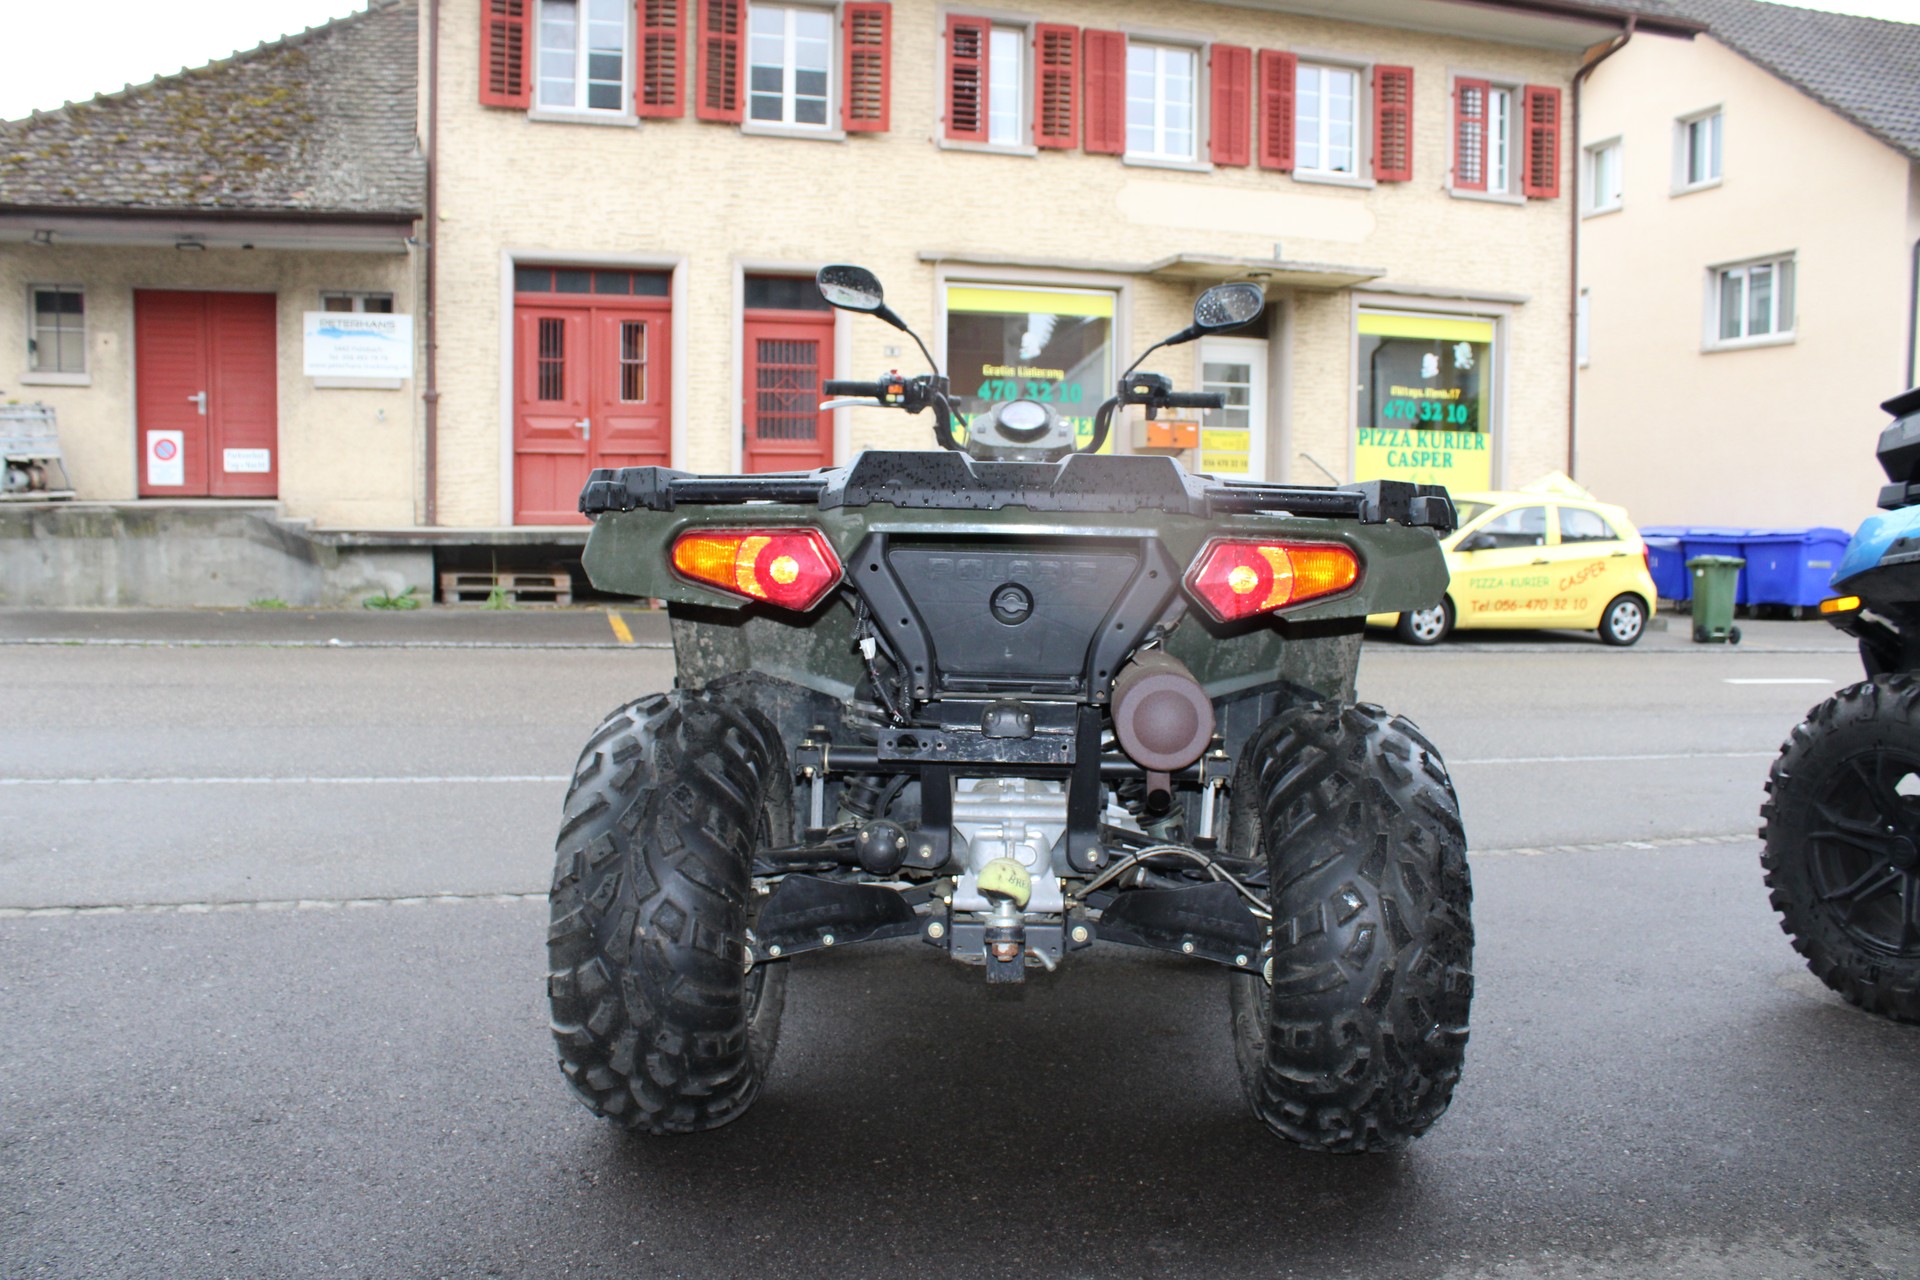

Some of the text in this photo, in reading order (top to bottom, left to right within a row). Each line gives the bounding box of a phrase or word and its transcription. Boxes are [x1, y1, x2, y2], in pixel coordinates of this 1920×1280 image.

[319, 319, 395, 328] PETERHANS
[977, 379, 1083, 403] 470 32 10
[1383, 399, 1468, 424] 470 32 10
[1359, 429, 1486, 450] PIZZA KURIER
[1387, 450, 1453, 468] CASPER
[928, 557, 1098, 583] POLARIS
[1559, 561, 1606, 592] CASPER
[1553, 598, 1568, 610] 32
[1574, 598, 1588, 610] 10
